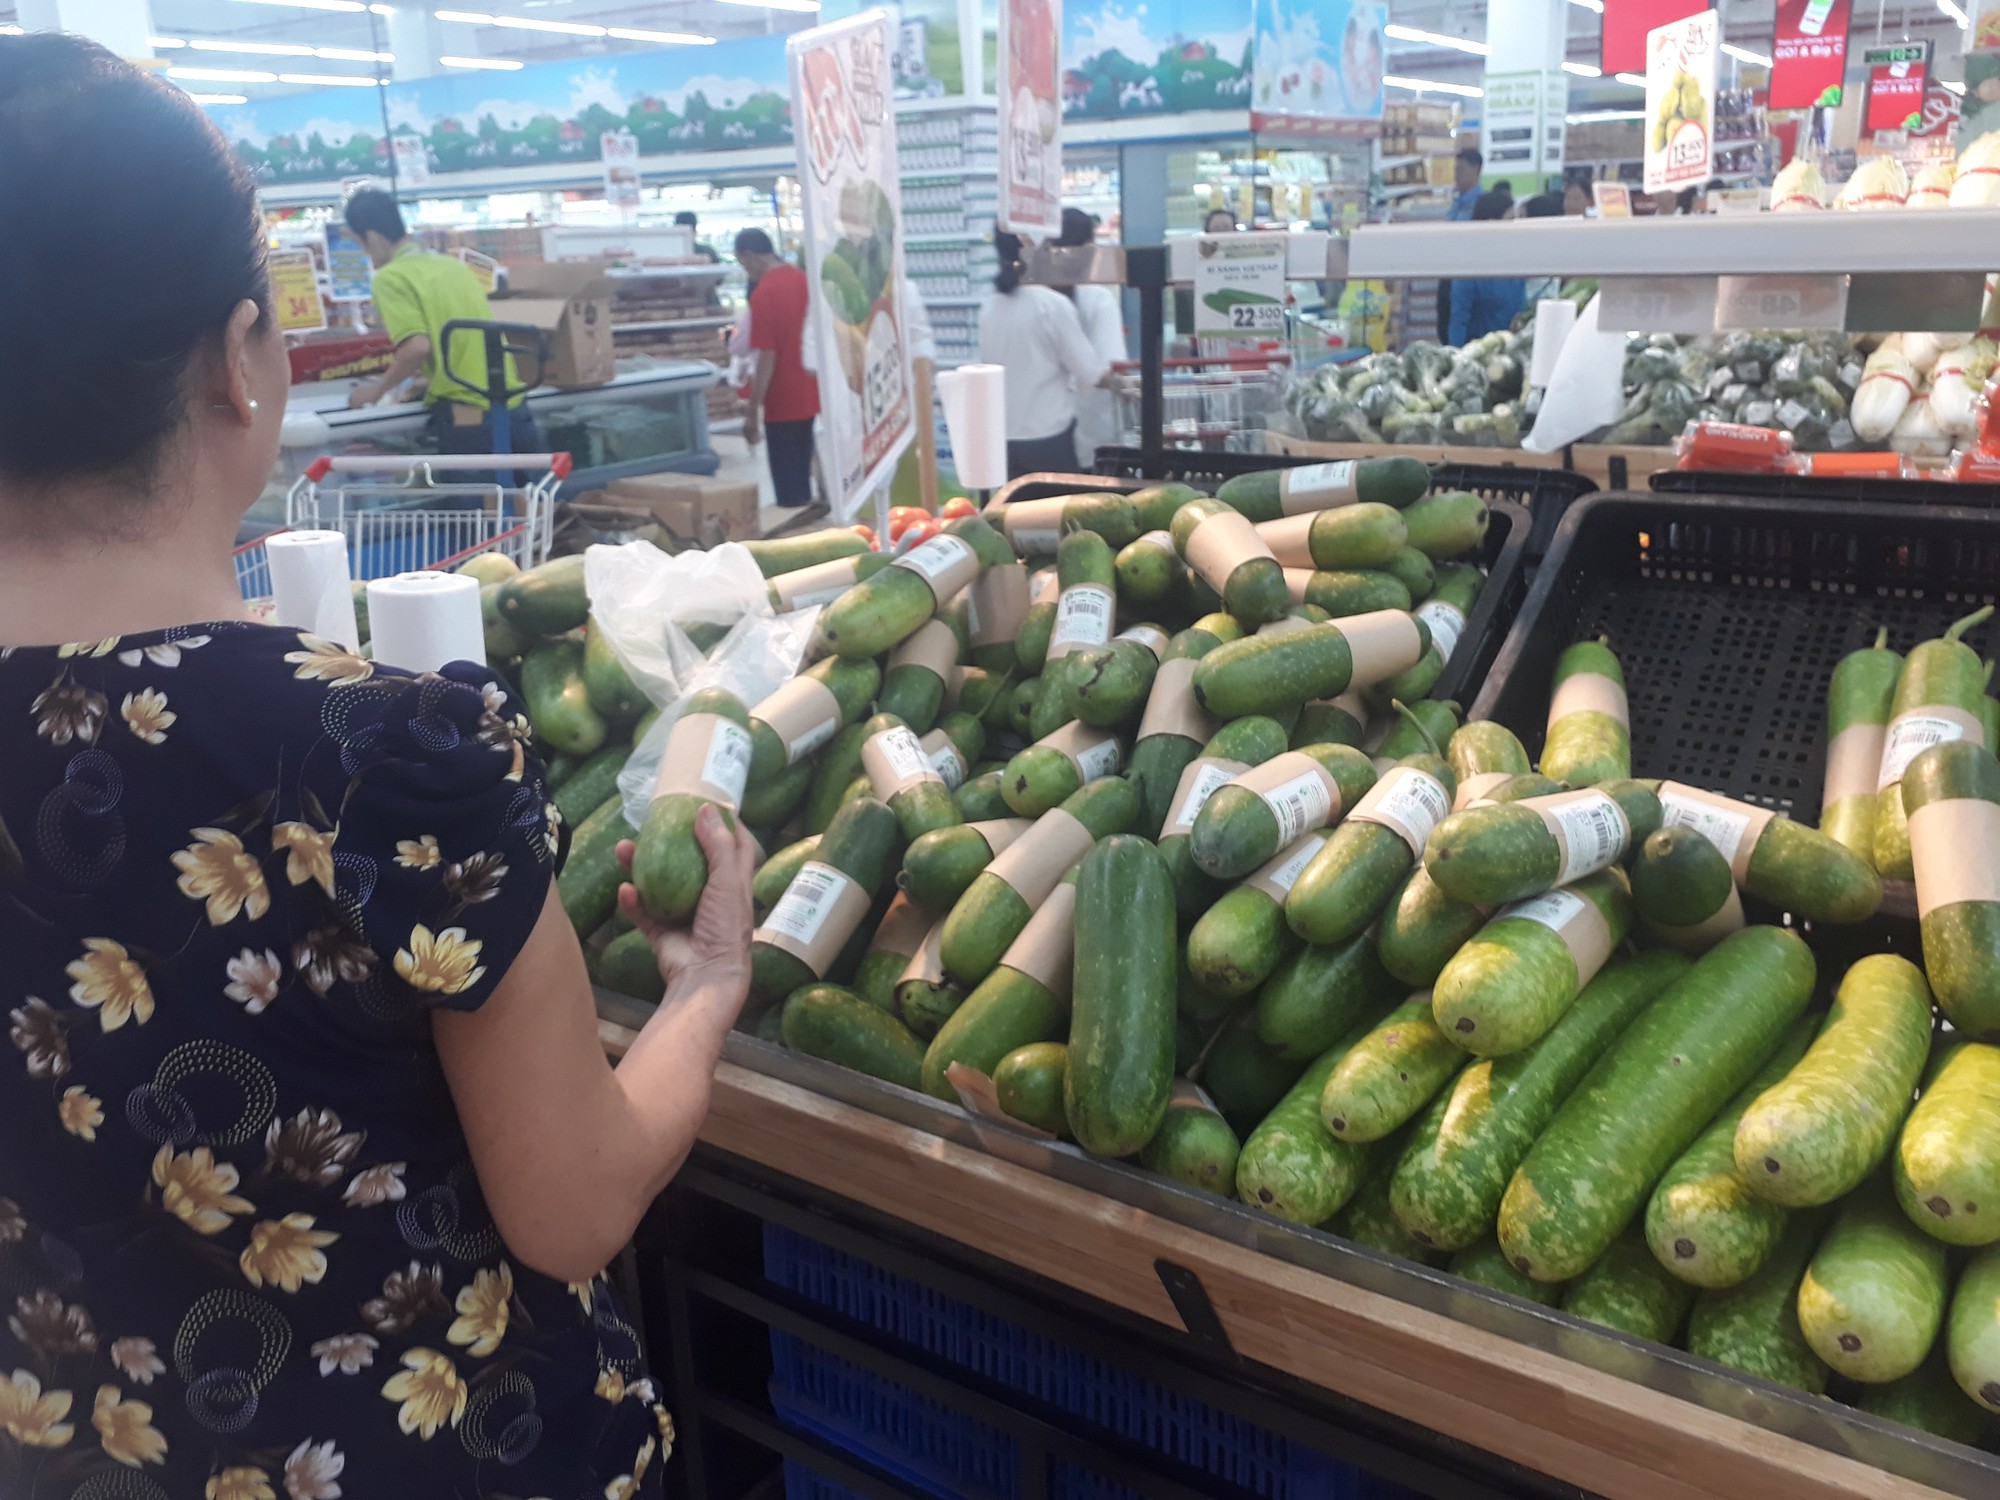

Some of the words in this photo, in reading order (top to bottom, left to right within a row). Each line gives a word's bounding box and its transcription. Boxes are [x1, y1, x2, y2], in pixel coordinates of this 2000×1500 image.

[1775, 46, 1798, 58] GO!
[1811, 44, 1831, 57] Big
[1833, 43, 1843, 55] C
[1234, 307, 1255, 328] 22
